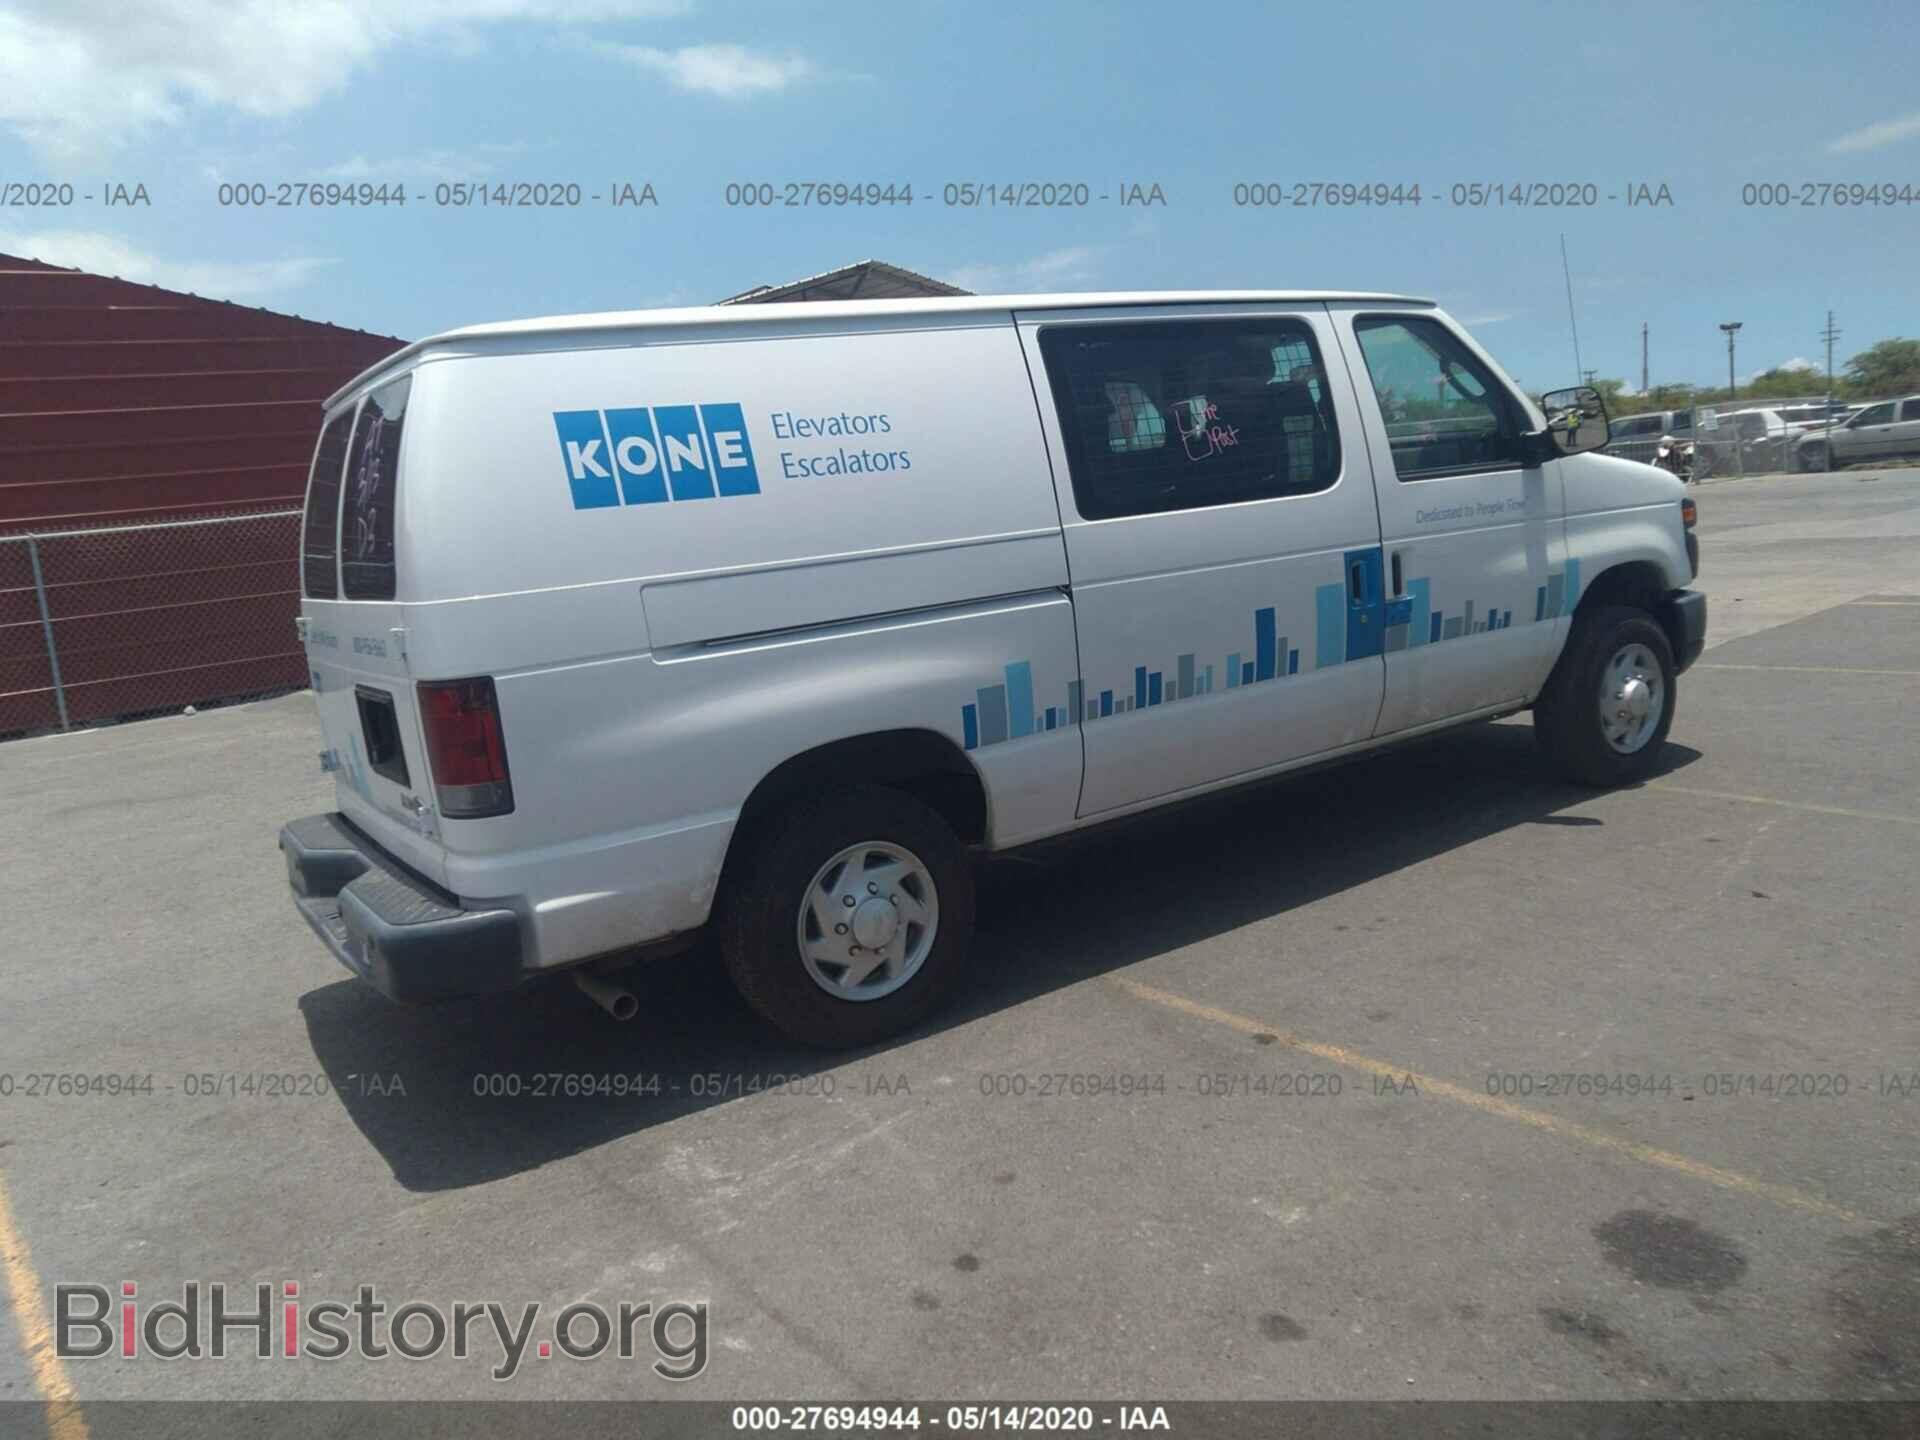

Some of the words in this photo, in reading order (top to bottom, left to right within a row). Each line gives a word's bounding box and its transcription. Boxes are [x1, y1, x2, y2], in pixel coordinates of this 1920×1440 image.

[771, 410, 891, 439] Elevators
[566, 432, 748, 480] KONE
[781, 448, 911, 479] Escalators
